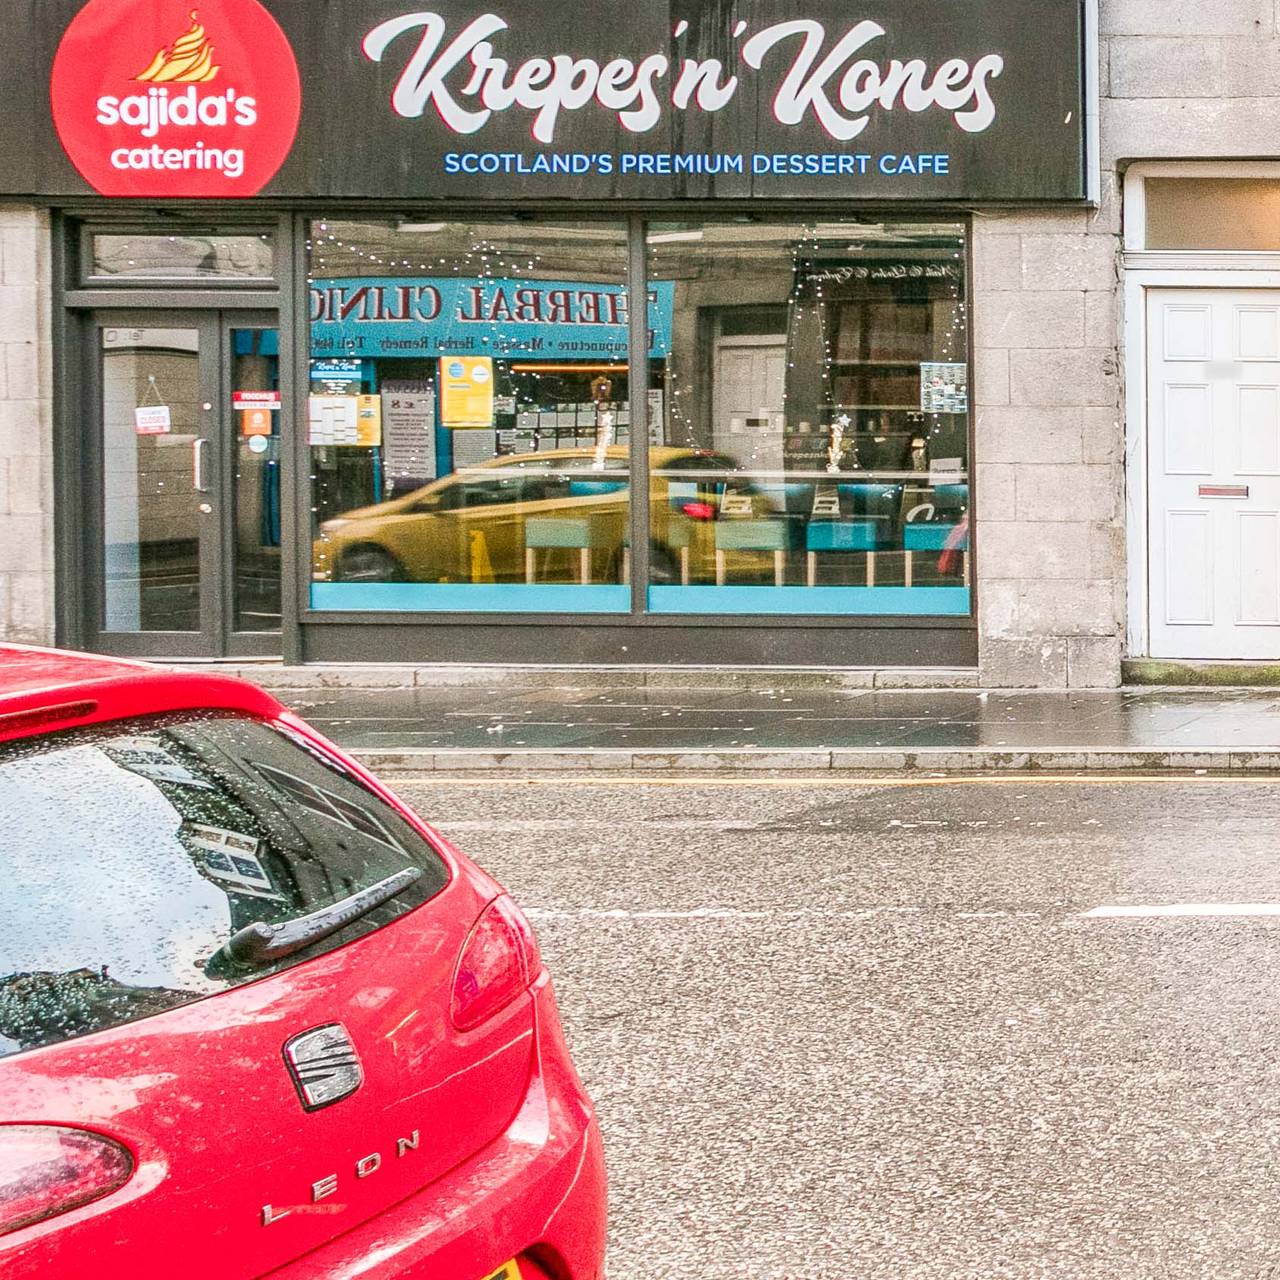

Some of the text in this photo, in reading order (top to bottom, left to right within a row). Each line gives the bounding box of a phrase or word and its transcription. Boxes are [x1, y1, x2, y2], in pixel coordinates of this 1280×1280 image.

[96, 87, 257, 137] sajida's
[110, 142, 245, 177] catering
[444, 153, 949, 175] SCOTLAND'S PREMIUM DESSERT CAFE
[260, 1129, 420, 1226] LEON
